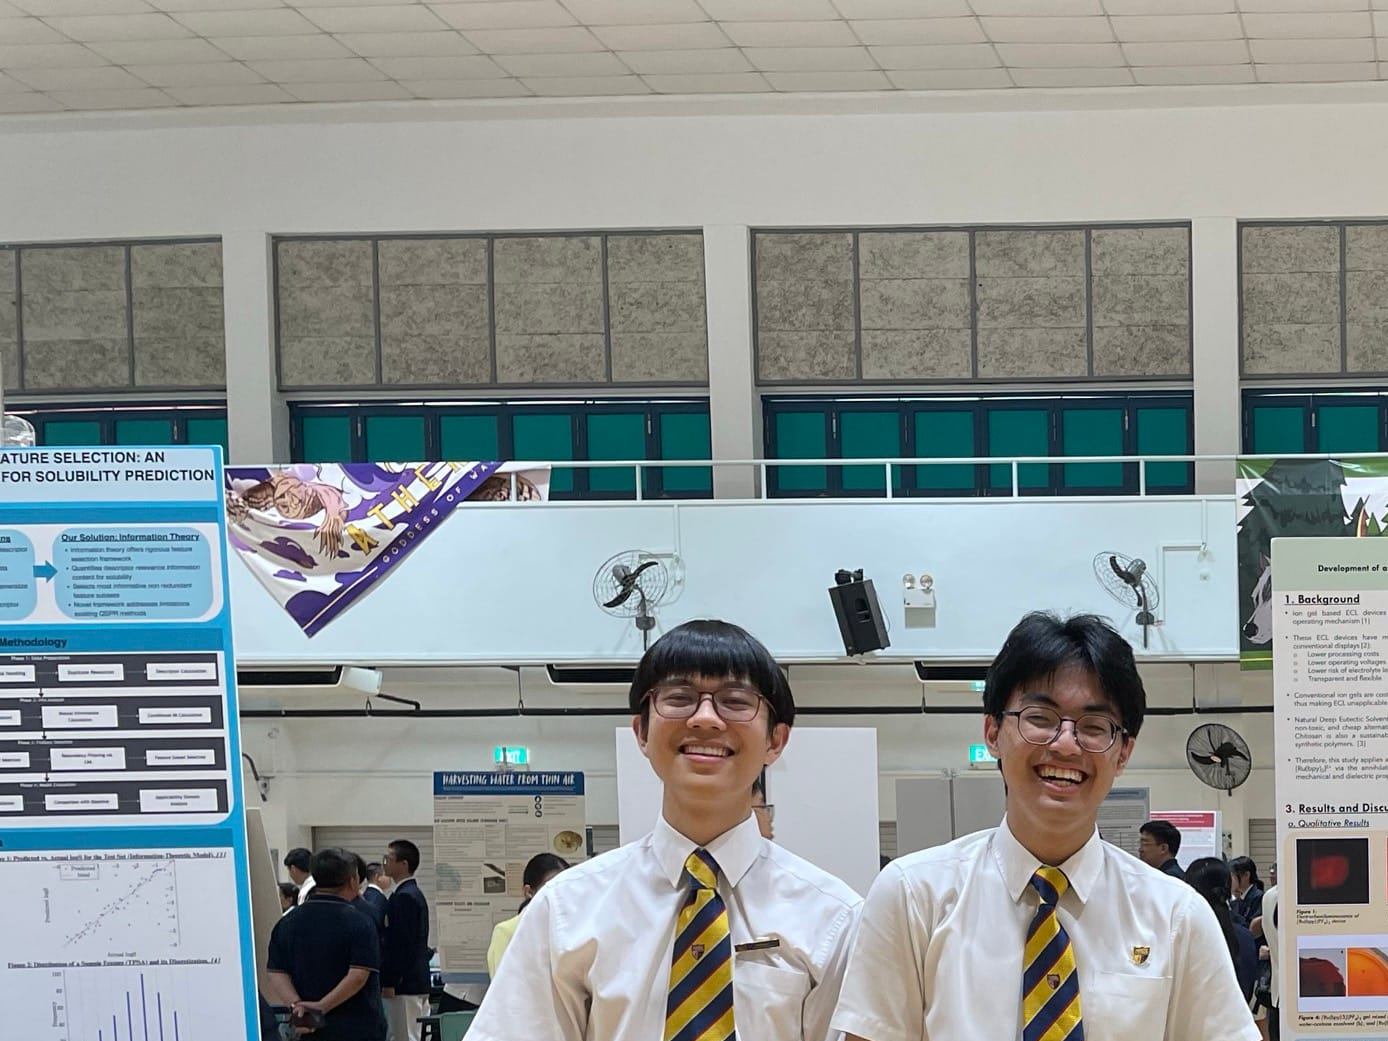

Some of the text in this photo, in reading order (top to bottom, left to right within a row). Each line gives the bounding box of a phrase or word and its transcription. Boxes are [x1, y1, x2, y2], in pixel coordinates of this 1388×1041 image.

[0, 451, 164, 464] ATURE SELECTION: AN
[1, 469, 214, 482] FOR SOLUBILITY PREDICTION
[382, 462, 494, 563] GODDESS OF WA
[61, 532, 200, 542] Our Solution: Information Theory
[1317, 564, 1369, 572] Development
[1284, 593, 1360, 606] 1. Background
[0, 636, 68, 649] Methodology
[1327, 659, 1358, 667] operating
[1359, 658, 1386, 666] voltages
[1348, 666, 1381, 674] electrolyte
[442, 774, 574, 785] HARVESTING WATER FROM THIN AIR
[1285, 804, 1295, 813] 3.
[1298, 803, 1335, 814] Results
[1339, 803, 1359, 814] and
[1298, 818, 1341, 829] Qualitative
[1344, 818, 1369, 828] Results
